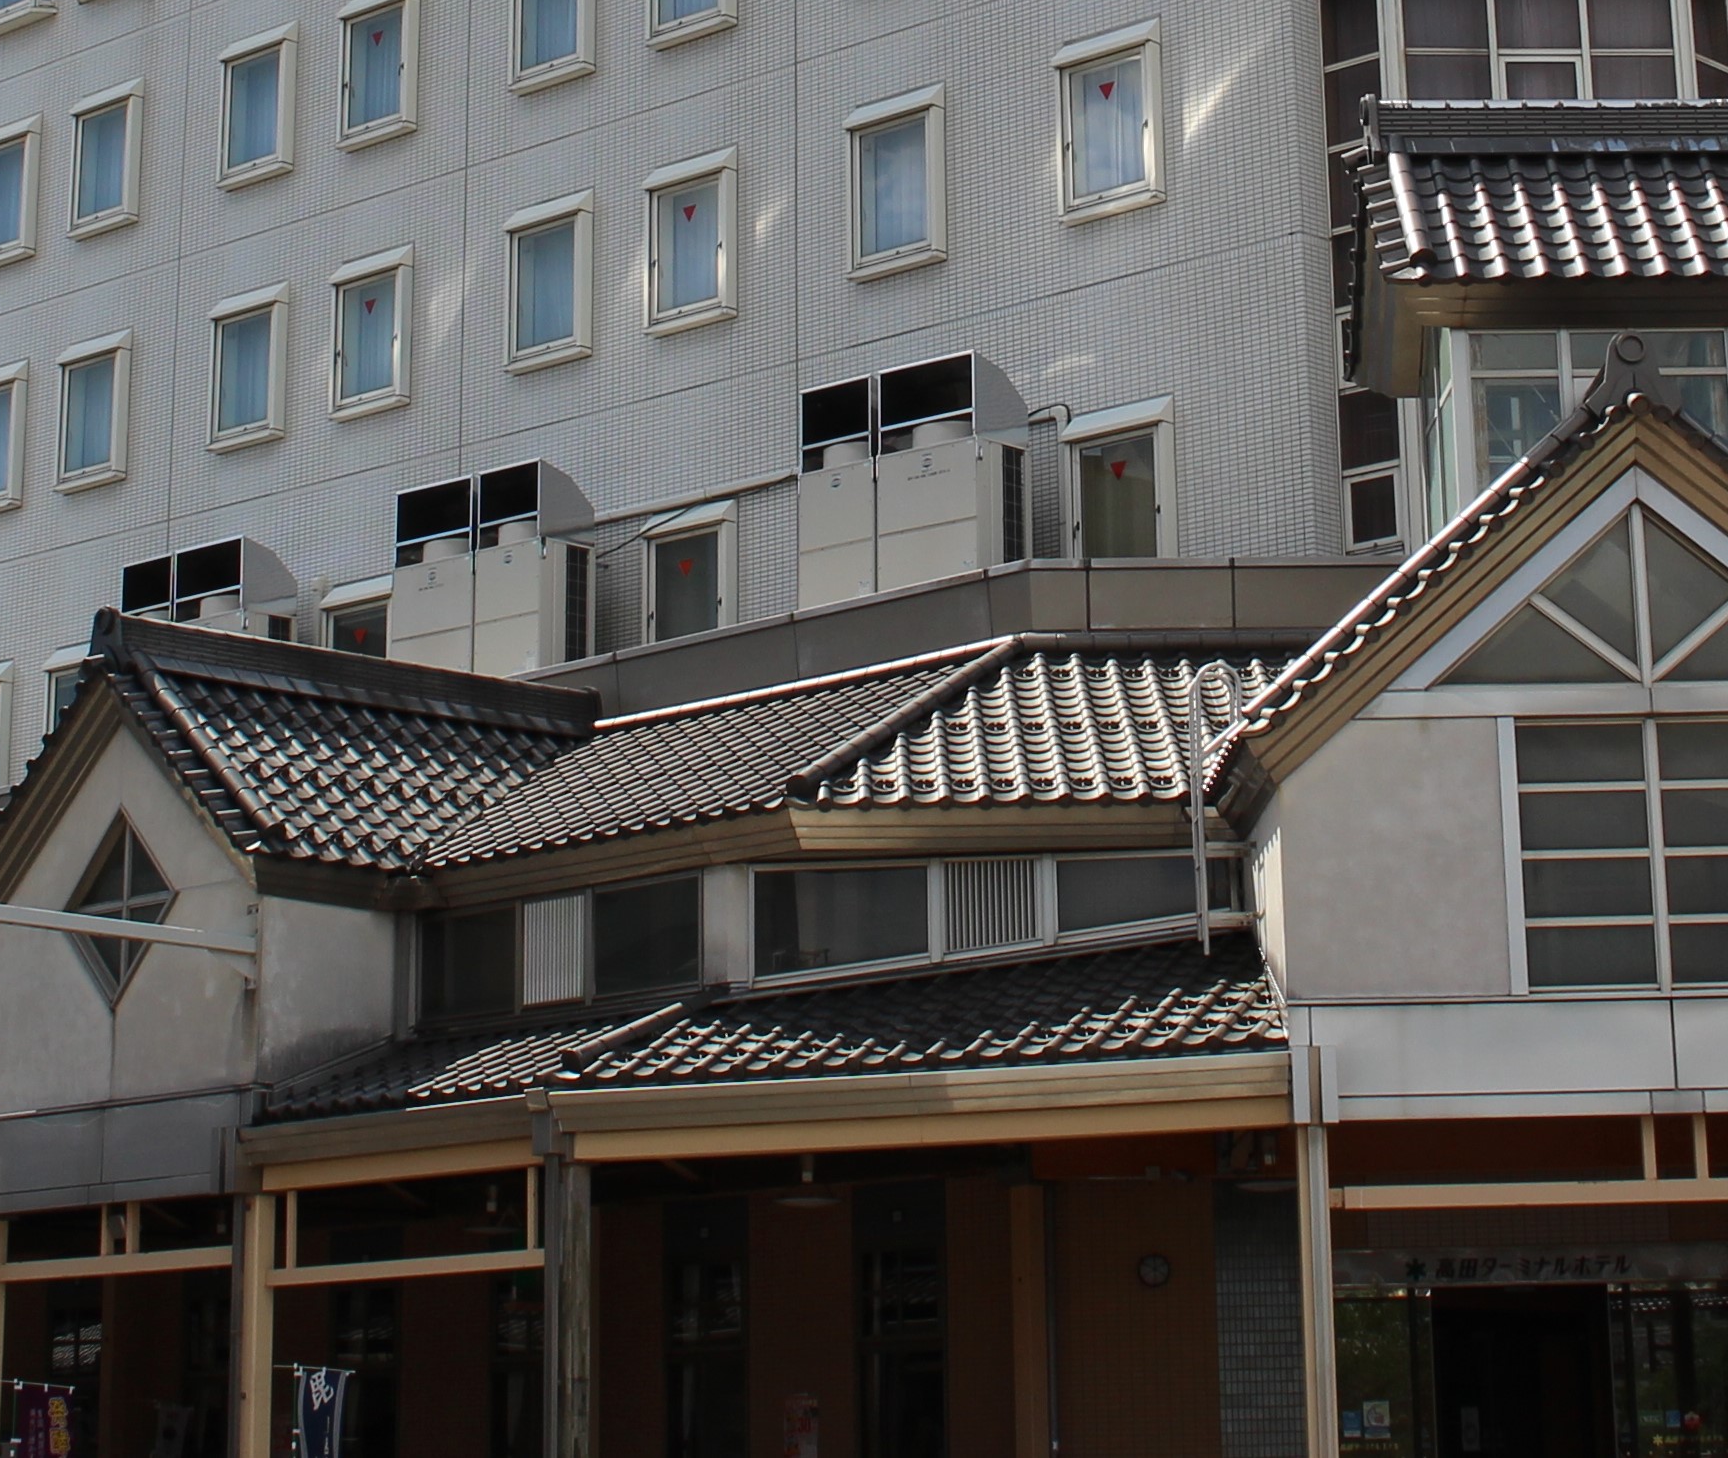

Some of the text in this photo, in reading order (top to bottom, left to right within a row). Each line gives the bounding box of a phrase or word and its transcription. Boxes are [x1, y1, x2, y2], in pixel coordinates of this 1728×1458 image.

[1435, 1254, 1633, 1280] 高田ターミナルホテル
